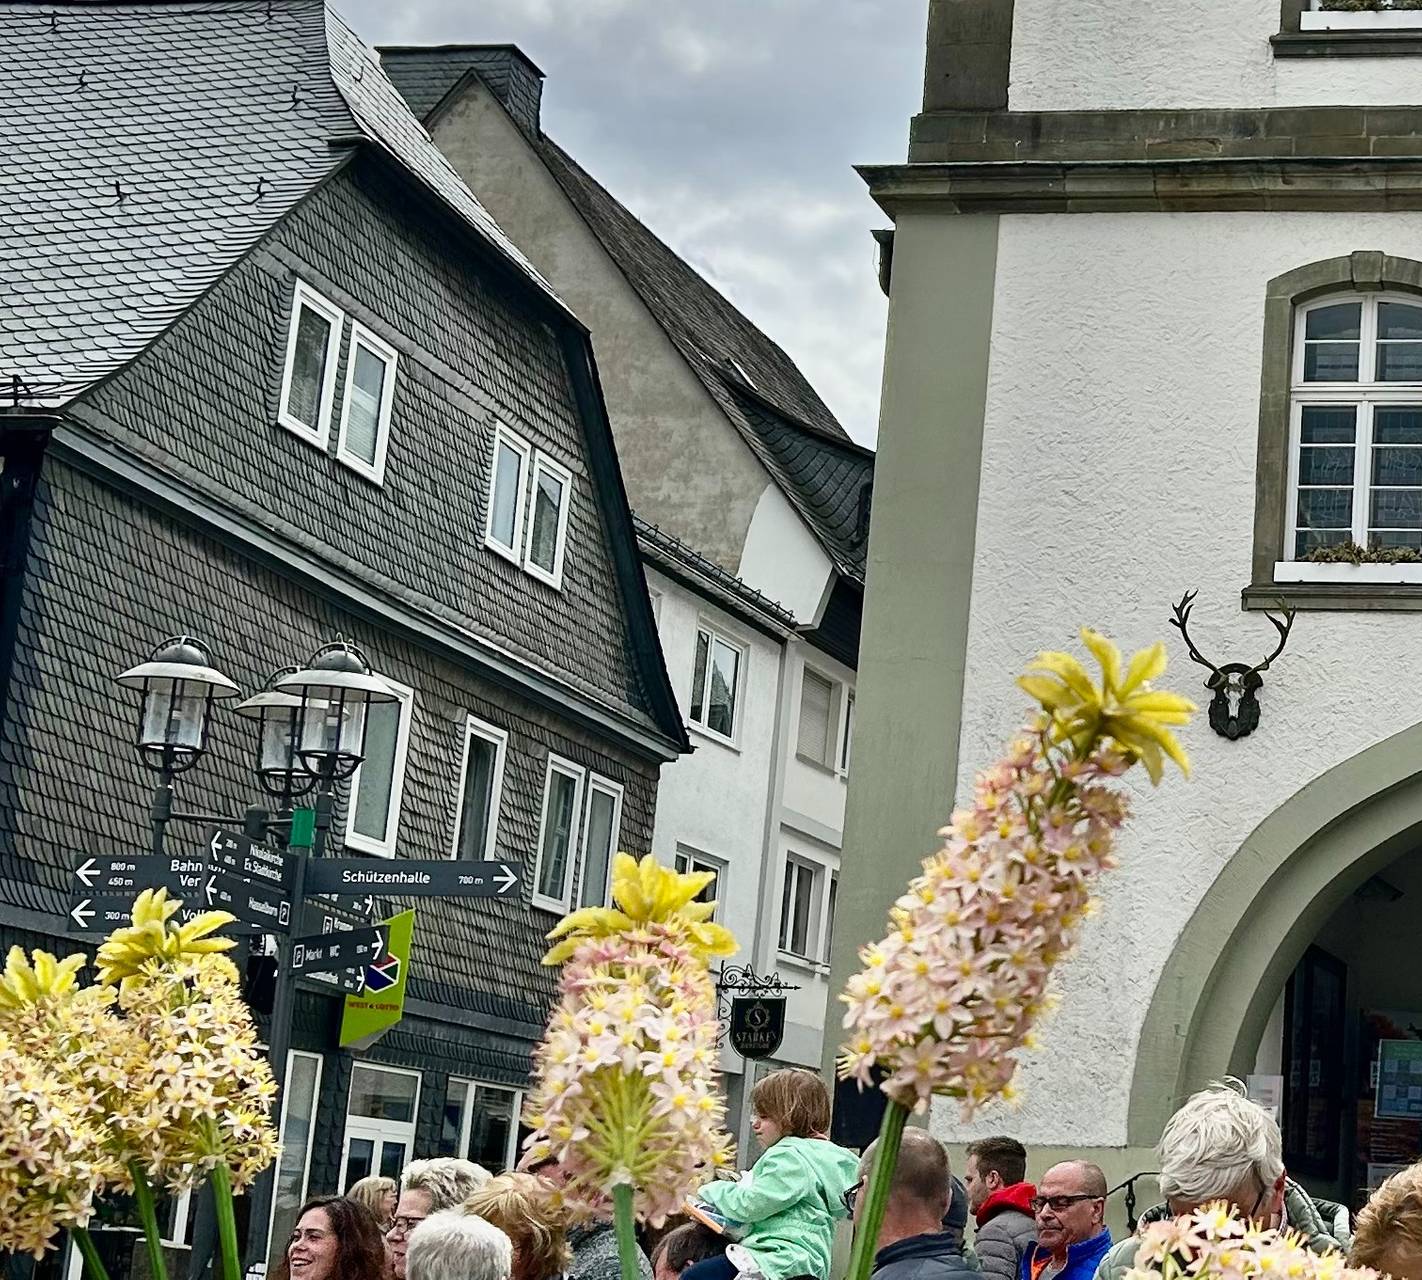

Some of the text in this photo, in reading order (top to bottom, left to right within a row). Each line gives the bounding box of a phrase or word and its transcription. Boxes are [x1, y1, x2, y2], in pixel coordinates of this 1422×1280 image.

[110, 862, 126, 871] 800
[342, 869, 431, 884] Schützenhalle
[104, 911, 120, 920] 300
